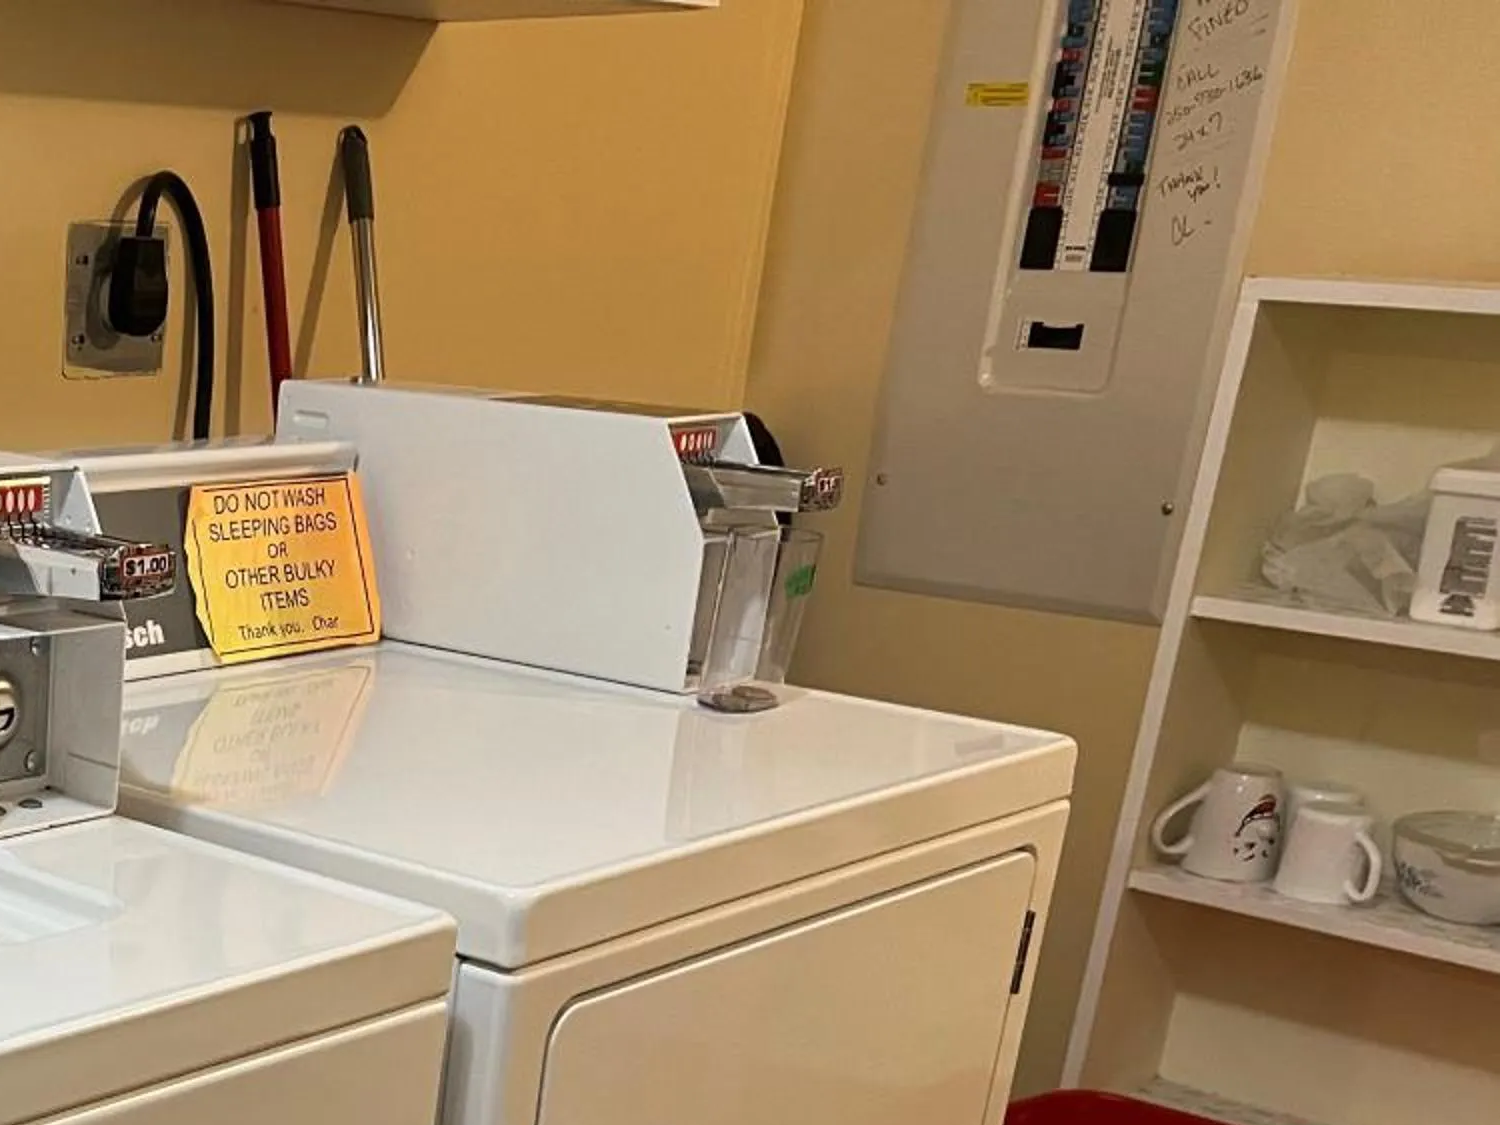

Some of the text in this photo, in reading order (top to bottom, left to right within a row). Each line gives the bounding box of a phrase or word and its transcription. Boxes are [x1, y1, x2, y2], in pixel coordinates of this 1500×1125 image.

[213, 487, 325, 515] DO NOT WASH
[209, 512, 338, 542] SLEEPING BAGS
[267, 542, 289, 559] OR
[125, 556, 168, 576] $1.00
[225, 559, 336, 589] OTHER BULKY
[260, 588, 310, 612] ITEMS
[238, 624, 277, 641] Thank
